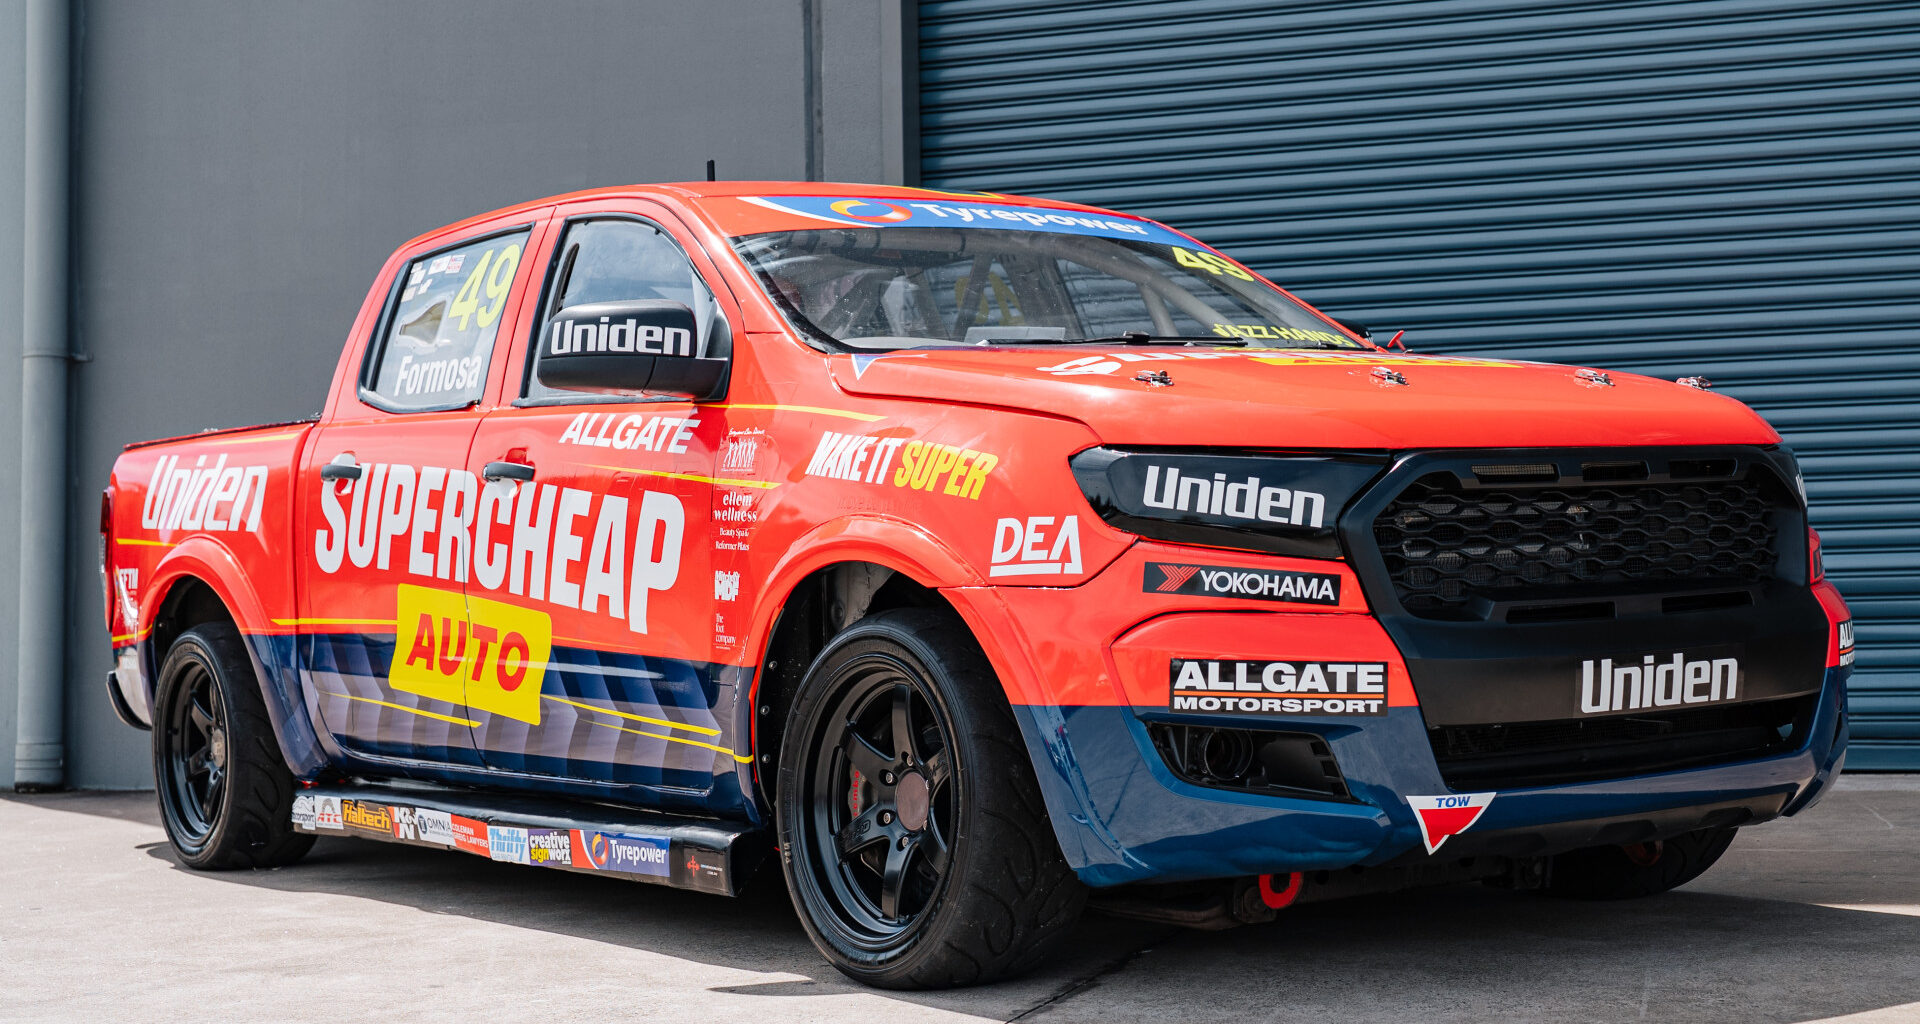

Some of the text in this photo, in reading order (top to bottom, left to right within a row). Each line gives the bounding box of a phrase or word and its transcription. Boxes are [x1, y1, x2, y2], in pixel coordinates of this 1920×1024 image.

[909, 203, 1148, 235] Tyrepower
[1172, 246, 1254, 282] 49
[448, 244, 521, 331] 49
[551, 316, 691, 356] Uniden
[1212, 323, 1356, 347] JAZZ HANDS
[394, 355, 482, 397] Formosa
[559, 413, 701, 454] ALLGATE
[805, 431, 998, 500] MAKE IT SUPER
[142, 453, 268, 532] Uniden
[722, 491, 752, 506] ellem
[1143, 465, 1325, 528] Uniden
[714, 507, 757, 522] wellness
[314, 452, 685, 635] SUPERCHEAP
[990, 515, 1083, 575] DEA
[1200, 570, 1335, 601] YOKOHAMA
[406, 613, 530, 692] AUTO
[1174, 661, 1384, 692] ALLGATE
[1580, 652, 1738, 714] Uniden
[1174, 696, 1383, 713] MOTORSPORT
[343, 803, 390, 829] Haltech
[1435, 796, 1471, 808] TOW
[466, 834, 489, 848] LAWYERS
[490, 828, 527, 862] Thrifty
[529, 832, 570, 849] creative
[531, 845, 571, 864] signworx
[610, 840, 667, 866] Tyrepower
